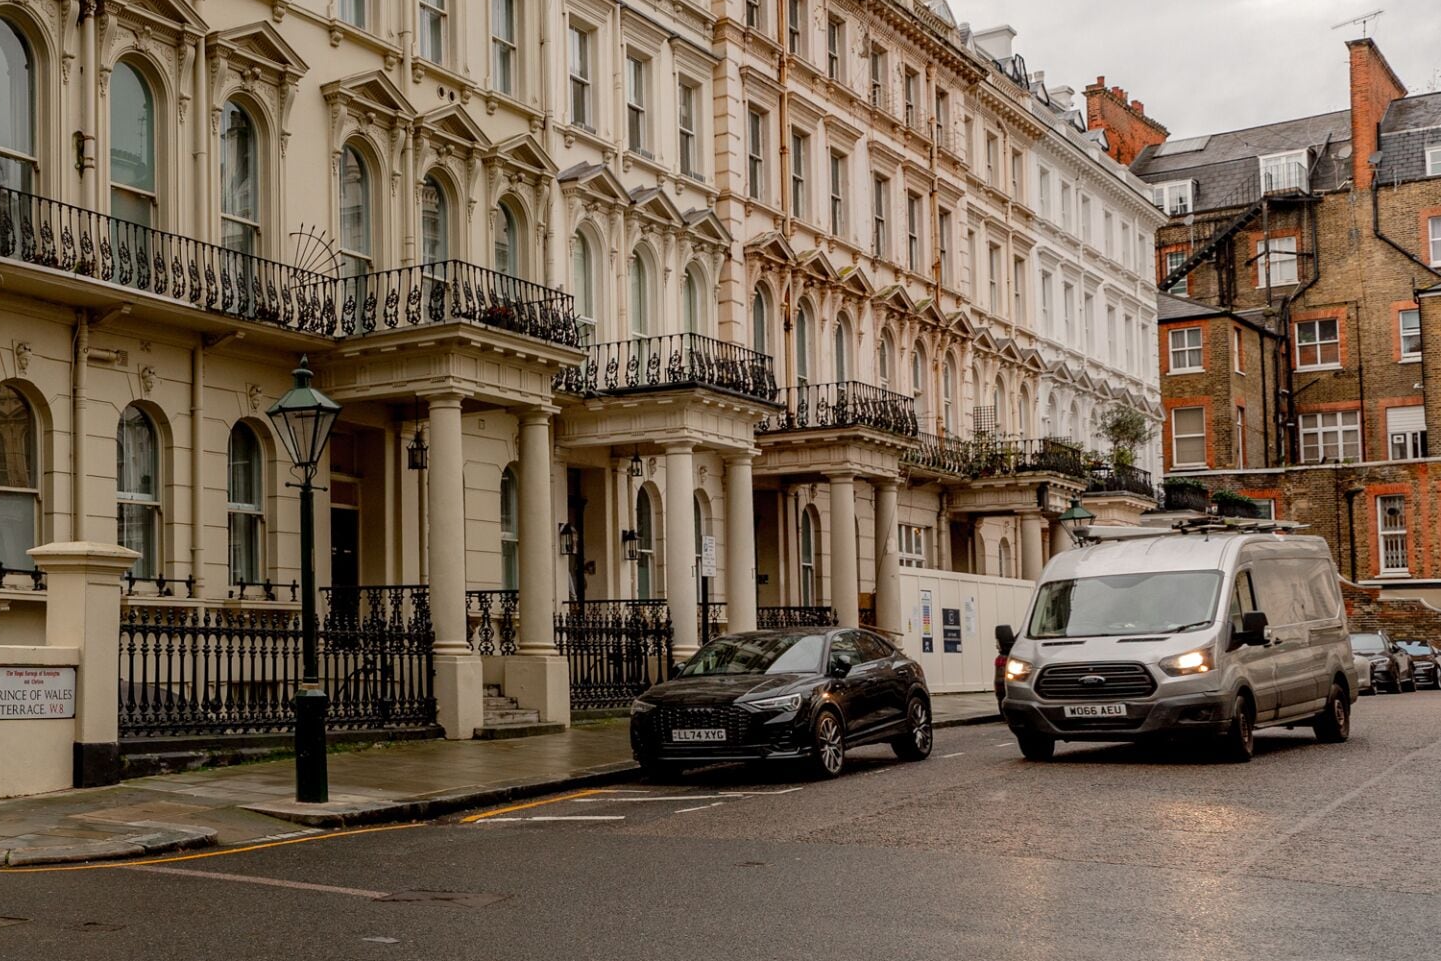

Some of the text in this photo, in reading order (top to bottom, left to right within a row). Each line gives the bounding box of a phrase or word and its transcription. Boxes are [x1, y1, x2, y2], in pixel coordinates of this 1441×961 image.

[29, 689, 42, 701] OF
[44, 688, 73, 700] WALES
[1101, 705, 1121, 714] AEU
[678, 730, 724, 739] LL74 XYG
